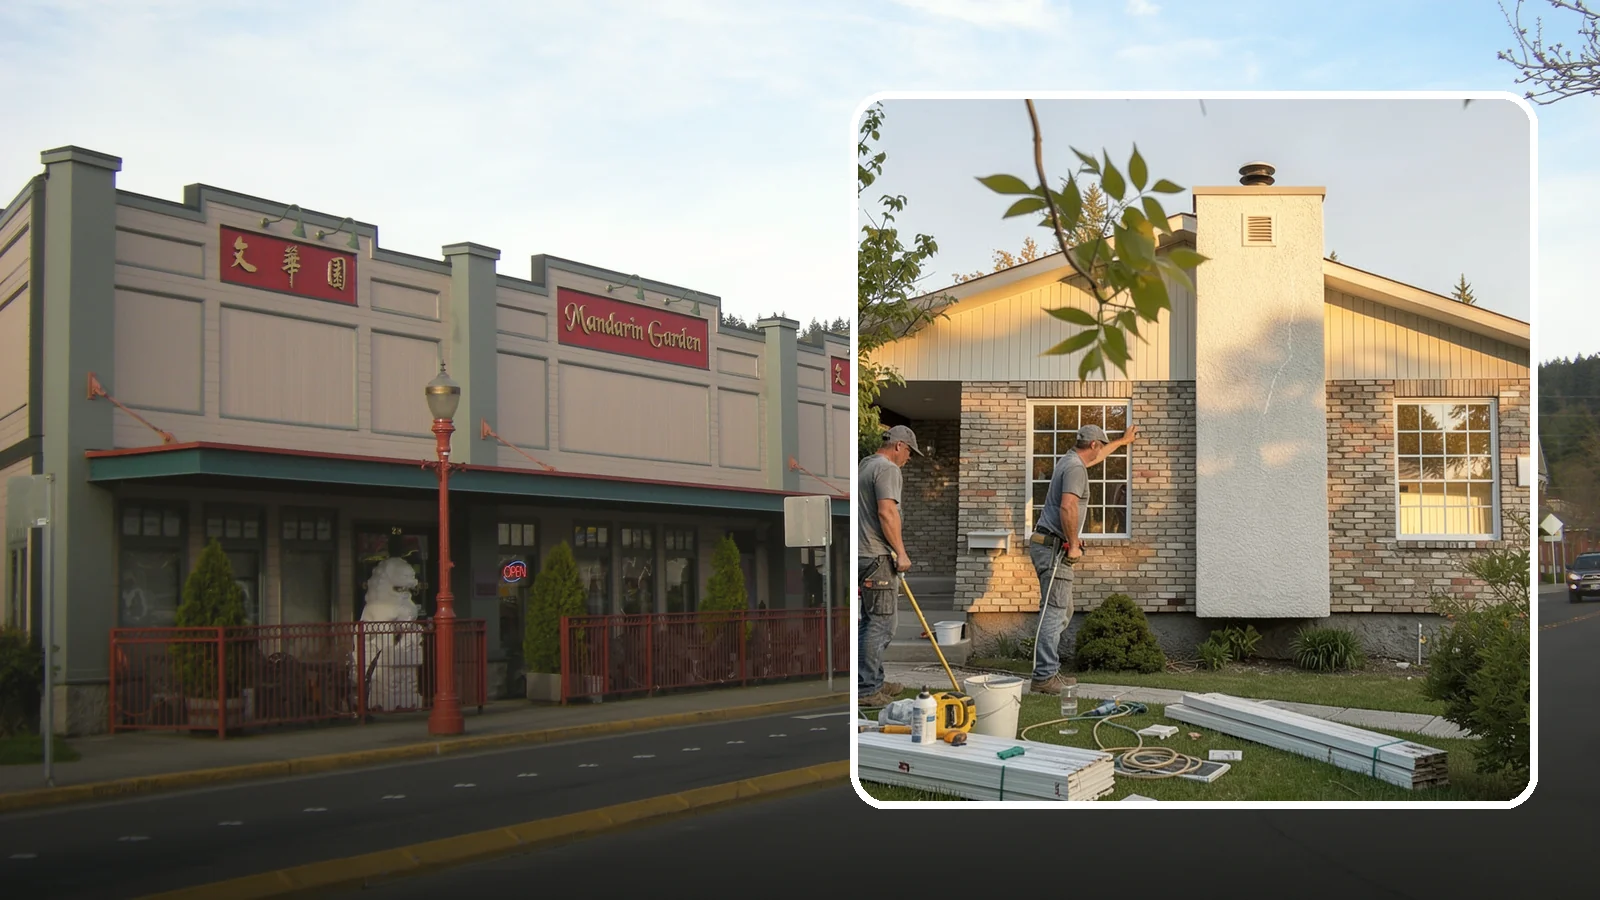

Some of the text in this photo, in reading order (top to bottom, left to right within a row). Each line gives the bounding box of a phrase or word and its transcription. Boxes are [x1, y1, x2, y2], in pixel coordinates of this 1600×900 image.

[231, 236, 345, 290] 文華園
[564, 302, 701, 352] Mandarin Garden
[503, 565, 527, 578] OPEN
